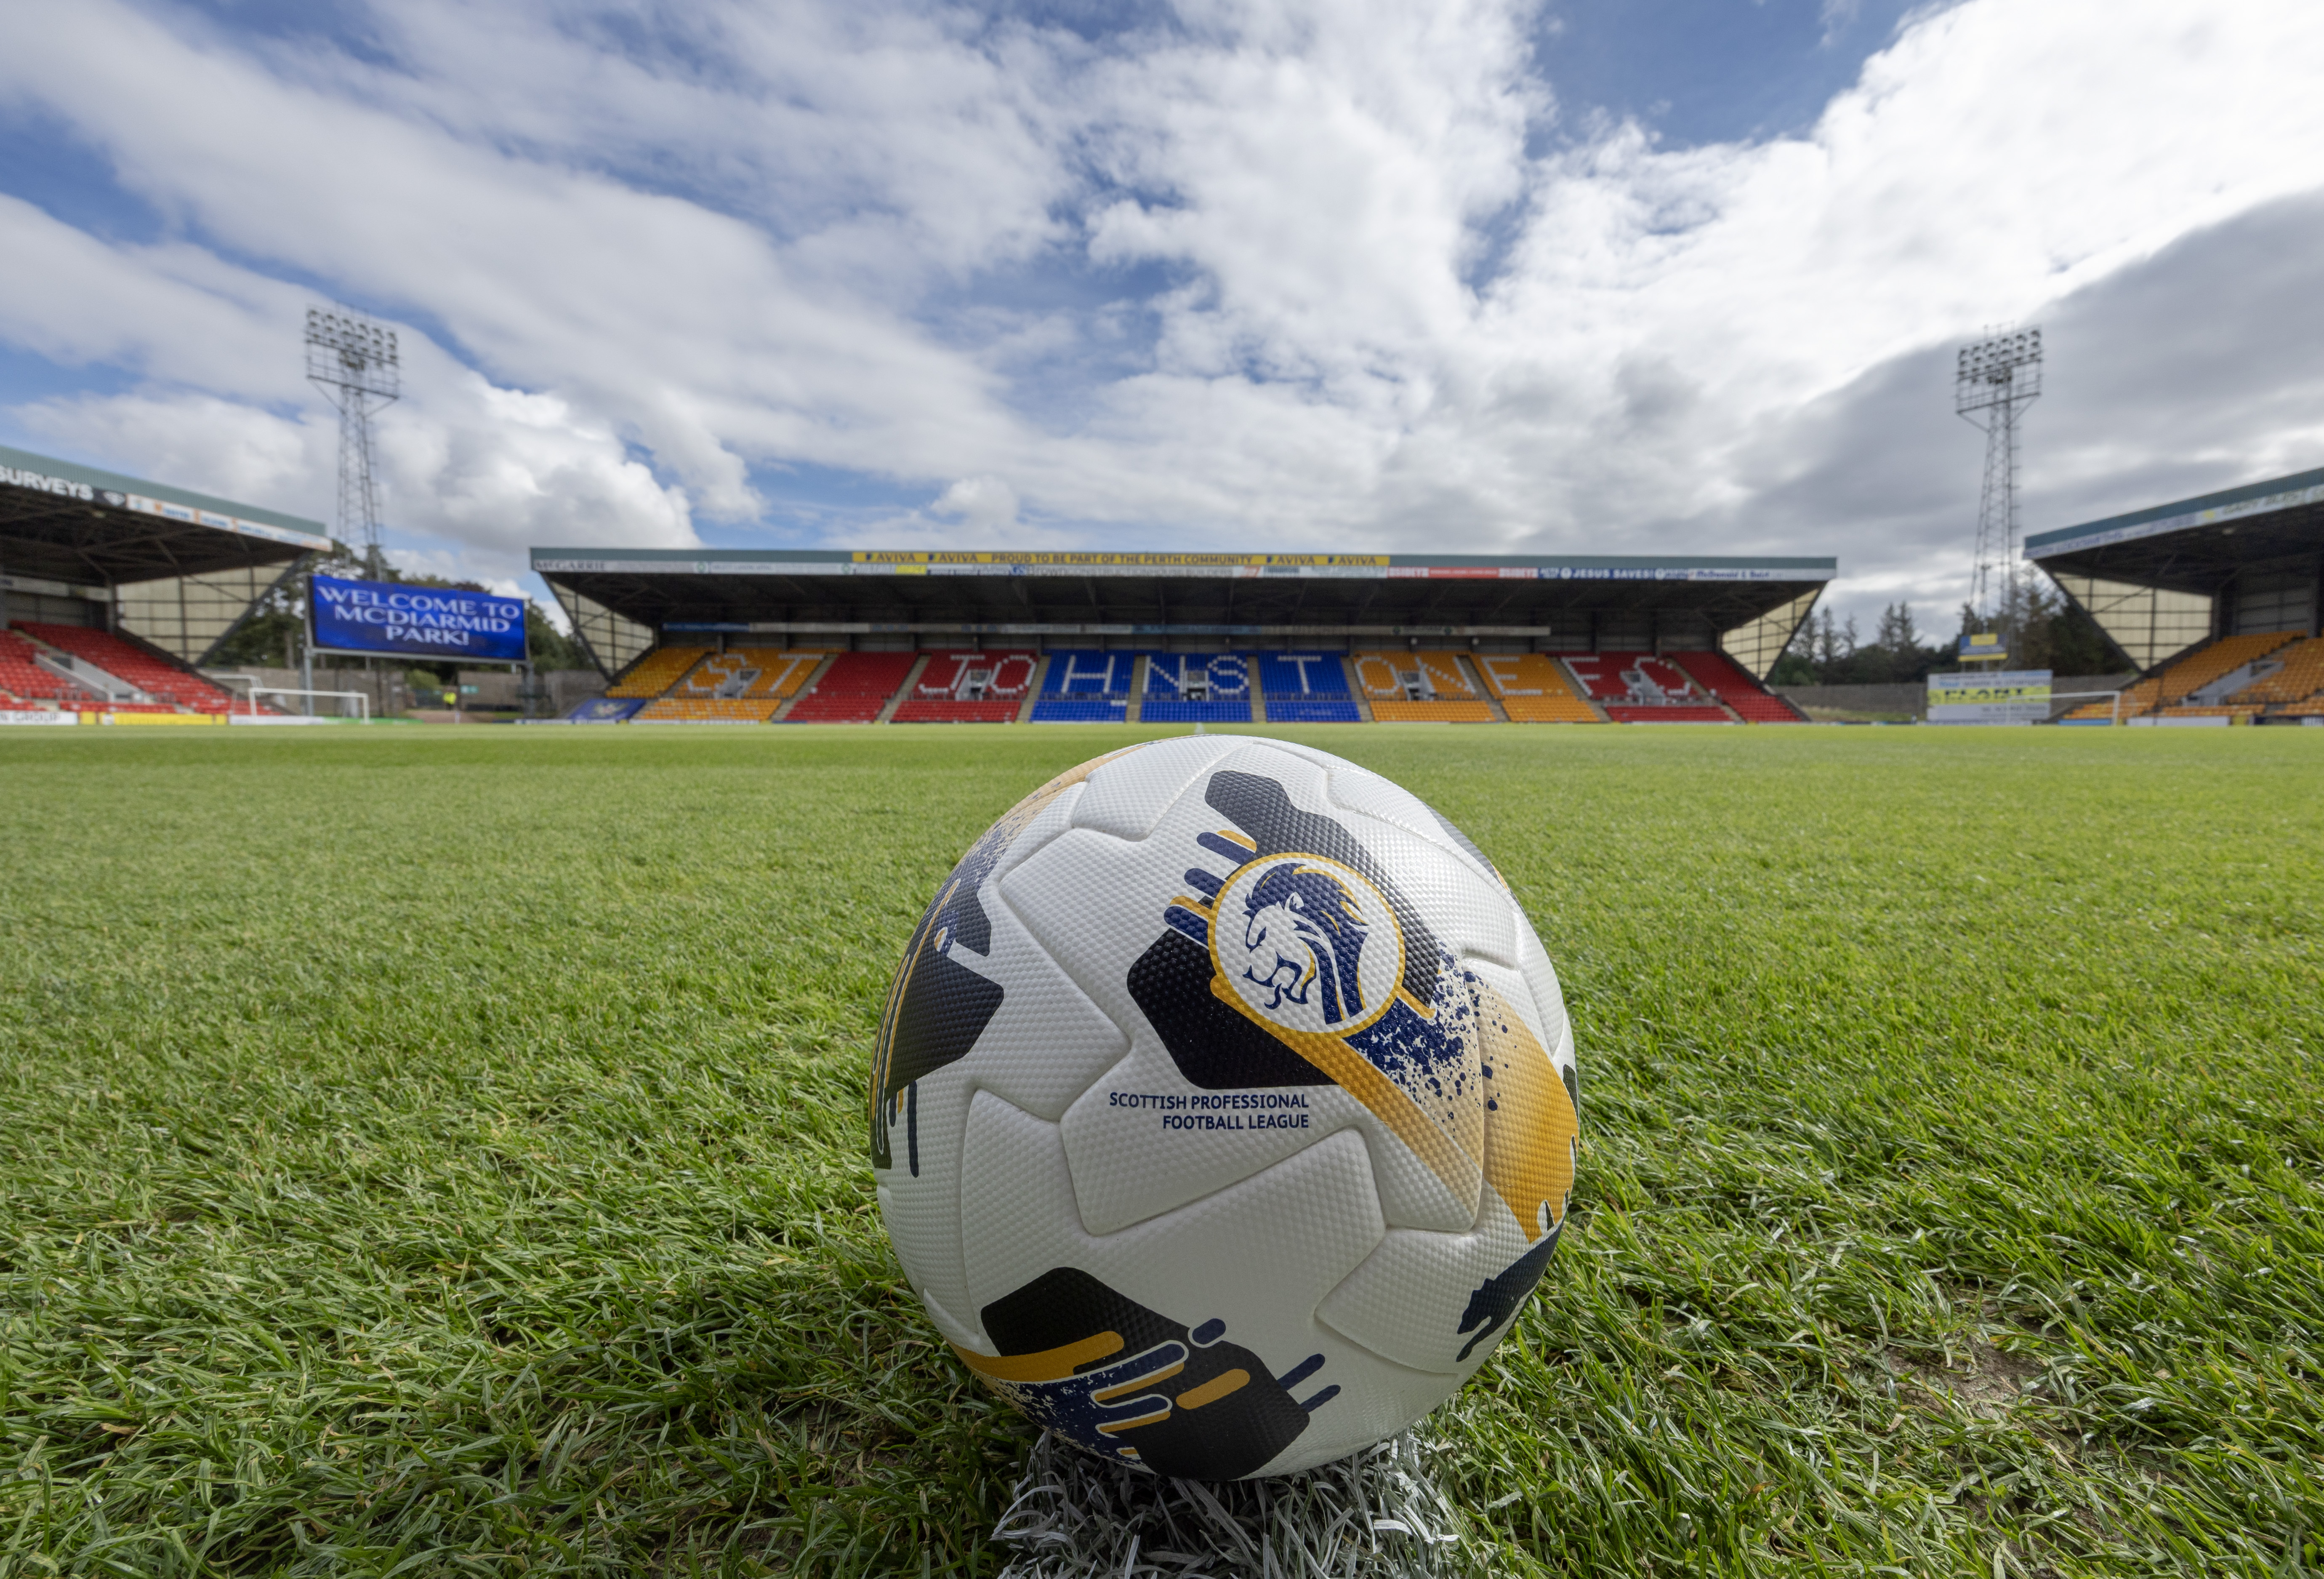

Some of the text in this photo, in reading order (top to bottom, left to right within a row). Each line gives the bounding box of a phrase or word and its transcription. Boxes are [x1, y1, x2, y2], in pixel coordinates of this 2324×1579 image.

[877, 553, 1377, 565] AVIVA AVIVA PROUD TO BE PART OF THE PERTH COMMUNITY AVIVA AVIVA
[1573, 569, 1653, 579] JESUS SAVES!
[317, 585, 520, 619] WELCOME TO
[335, 605, 510, 632] MCDIARMID
[386, 625, 469, 646] PARK!
[1110, 1092, 1309, 1109] SCOTTISH PROFESSIONAL
[1163, 1114, 1309, 1129] FOOTBALL LEAGUE
